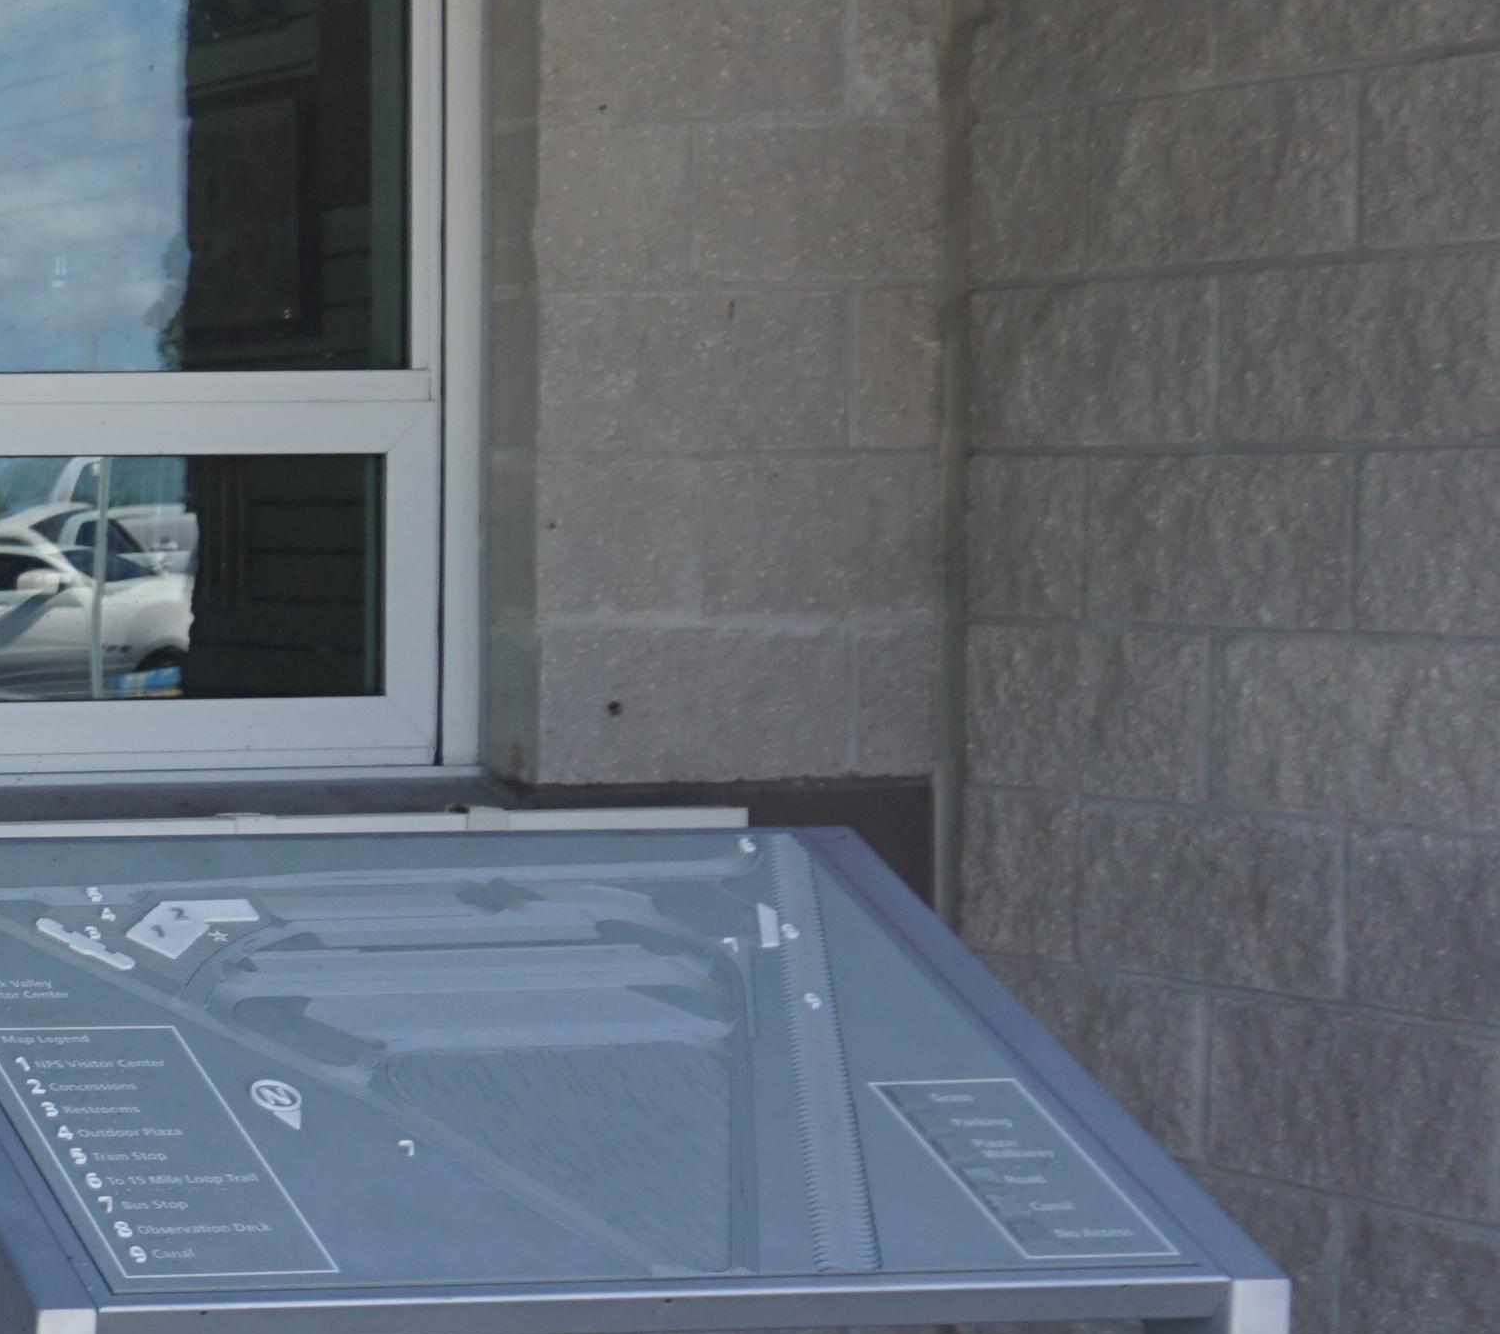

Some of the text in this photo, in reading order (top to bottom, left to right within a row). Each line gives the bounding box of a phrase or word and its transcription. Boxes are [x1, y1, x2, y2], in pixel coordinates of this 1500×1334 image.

[1, 1035, 90, 1045] Map Legend
[15, 1056, 165, 1072] 1 NPS Visitor Center
[26, 1079, 138, 1094] 2 Concessions
[41, 1101, 140, 1118] 3 Restrooms
[57, 1125, 182, 1140] 4 Outdoor Plaza
[70, 1148, 167, 1165] 5 Tram Stop
[86, 1173, 259, 1189] 6 To 15 Mile Loop Trail
[98, 1196, 188, 1213] 7 Bus Stop
[114, 1221, 271, 1238] 8 Observation Deck
[129, 1245, 196, 1263] 9 Canal
